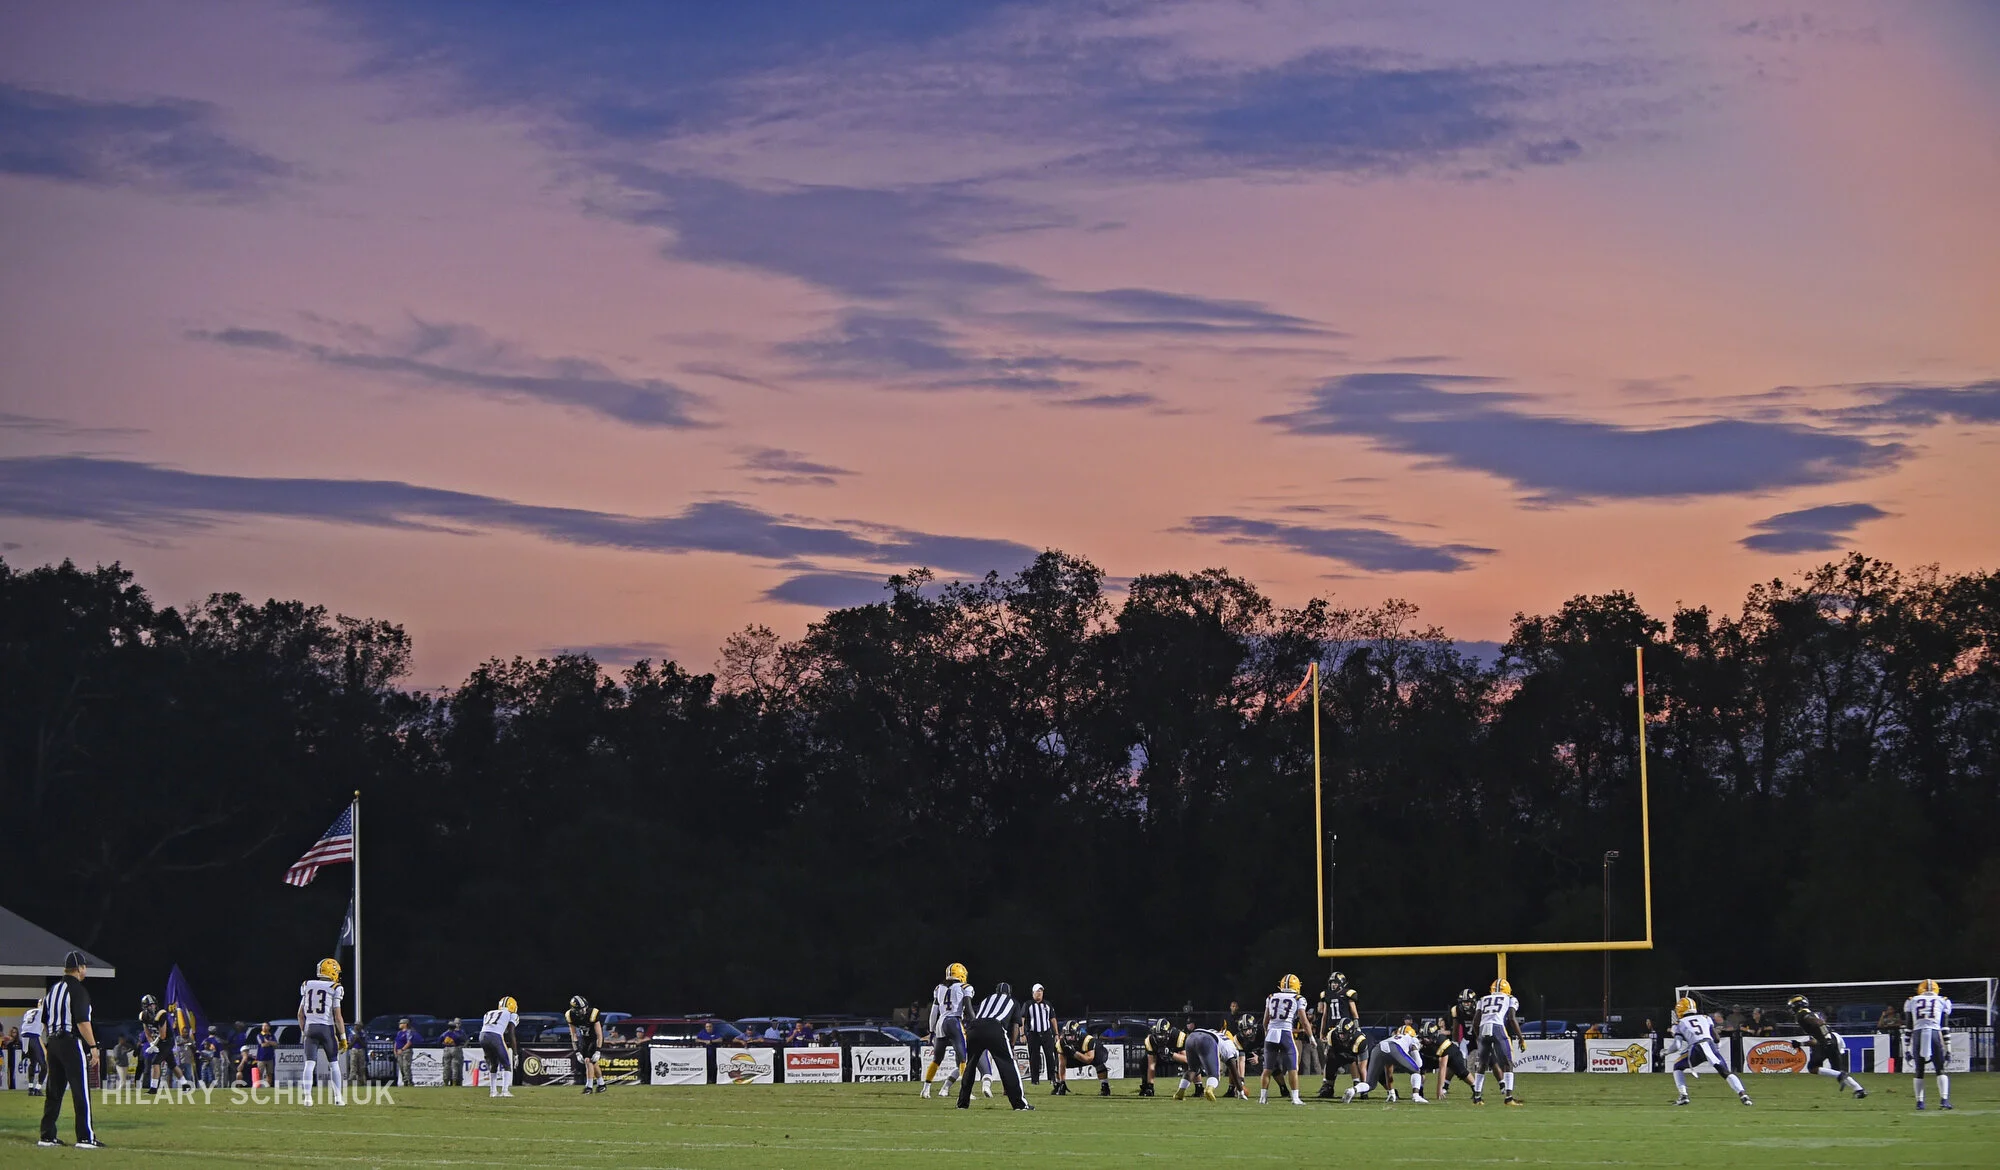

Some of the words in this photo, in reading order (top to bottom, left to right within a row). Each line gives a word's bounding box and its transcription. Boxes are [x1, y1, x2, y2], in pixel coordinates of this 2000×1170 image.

[307, 989, 327, 1014] 13
[943, 988, 952, 1011] 4
[1482, 996, 1505, 1014] 25
[1269, 998, 1293, 1020] 33
[1330, 1002, 1342, 1020] 11
[1916, 998, 1936, 1020] 21
[1689, 1018, 1704, 1036] 5
[279, 1053, 304, 1063] Action
[1755, 1043, 1798, 1056] Dependable
[540, 1058, 572, 1067] GAUTHIER
[612, 1058, 639, 1067] Scott
[855, 1050, 905, 1073] Venue
[1513, 1054, 1557, 1069] BATEMAN'S
[1592, 1058, 1624, 1066] PICOU
